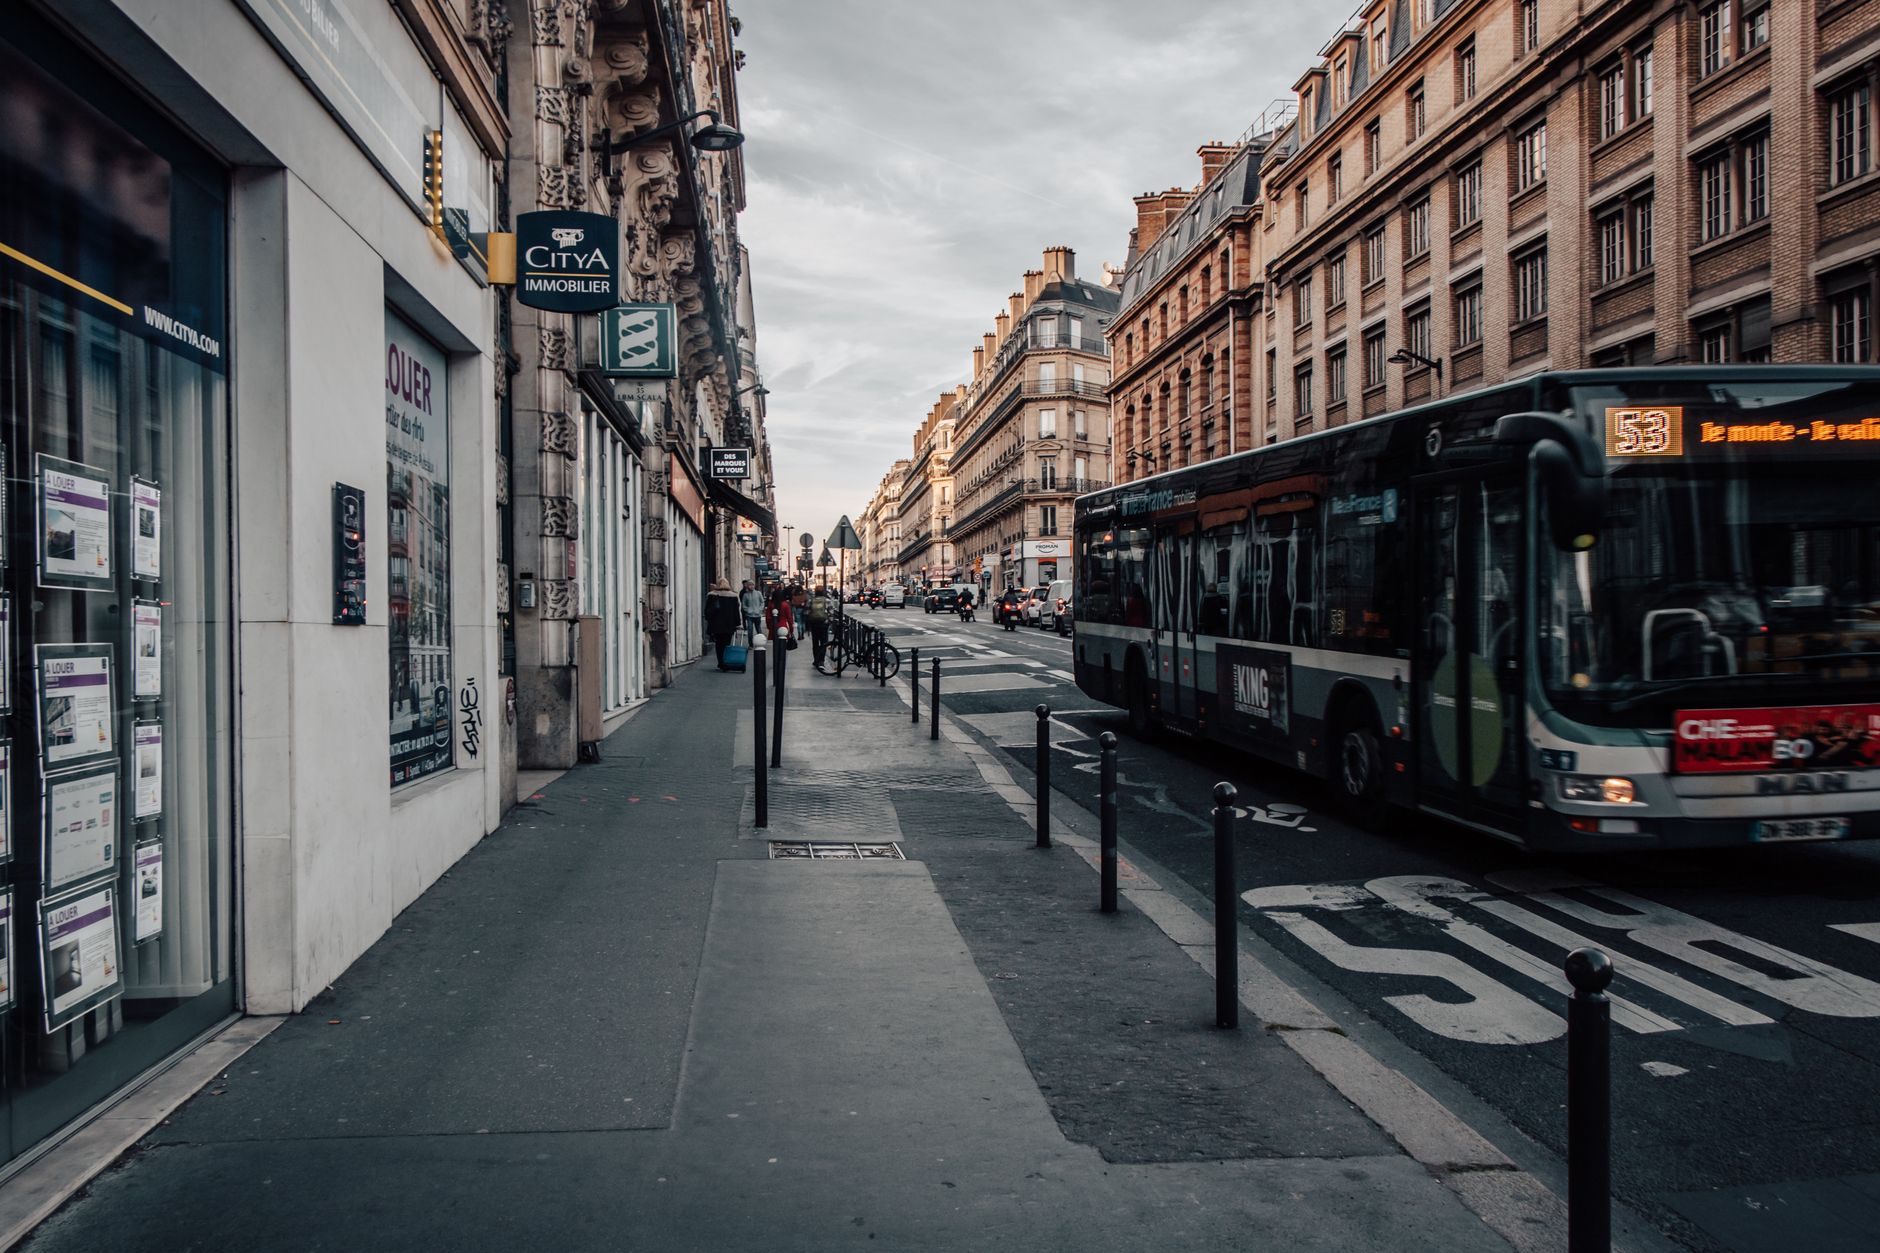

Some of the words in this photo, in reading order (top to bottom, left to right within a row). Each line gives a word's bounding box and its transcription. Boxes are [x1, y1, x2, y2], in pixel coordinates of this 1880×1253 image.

[525, 278, 610, 294] IMMOBILIER
[144, 305, 220, 358] WWW.CITYA.COM
[385, 342, 432, 416] OUER
[636, 393, 662, 401] SCALA
[1614, 410, 1670, 454] 53
[53, 476, 75, 490] LOUER
[52, 662, 75, 675] LOUER
[1237, 664, 1269, 709] KING
[1679, 718, 1739, 740] CHE
[1754, 771, 1849, 795] MAN
[55, 905, 78, 924] LOUER
